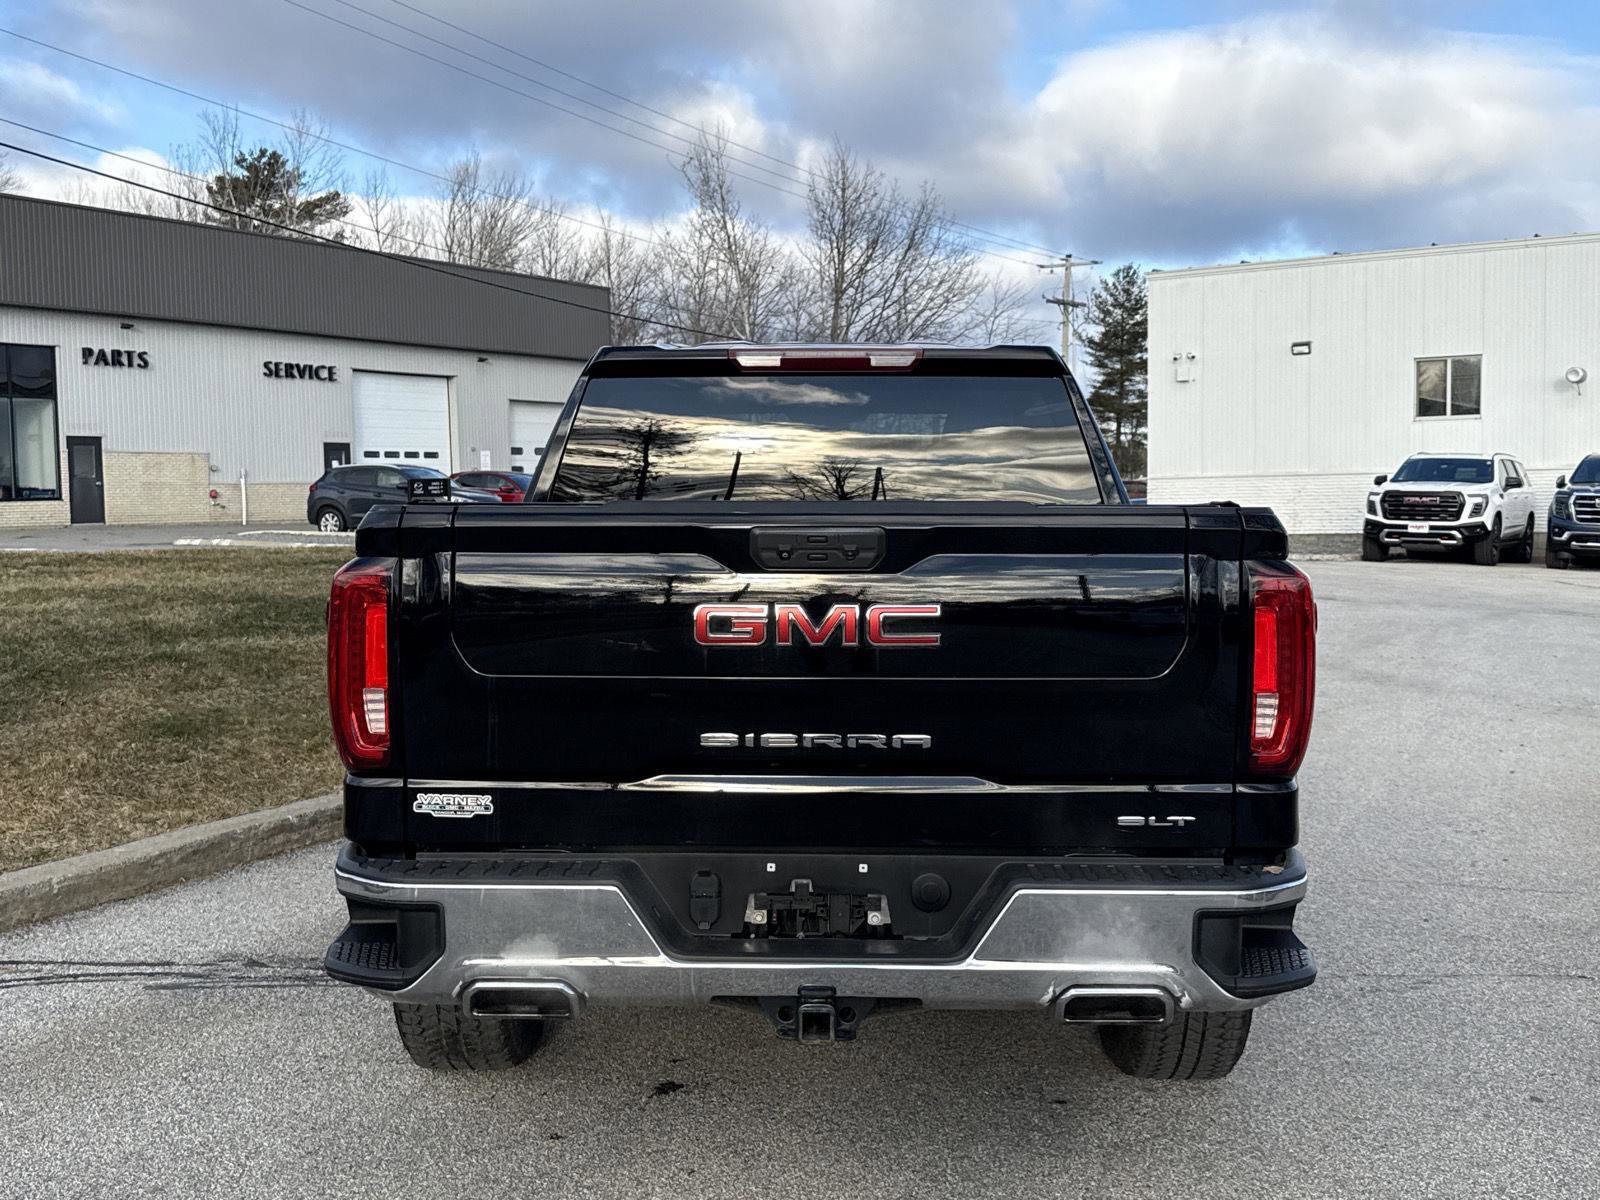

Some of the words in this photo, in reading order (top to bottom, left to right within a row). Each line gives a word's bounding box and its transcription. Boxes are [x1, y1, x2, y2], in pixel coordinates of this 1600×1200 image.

[81, 347, 150, 369] PARTS
[262, 360, 338, 382] SERVICE
[693, 603, 942, 647] GMC
[699, 732, 932, 749] SIERRA
[417, 794, 491, 806] VARNEY
[1117, 815, 1196, 827] SLT
